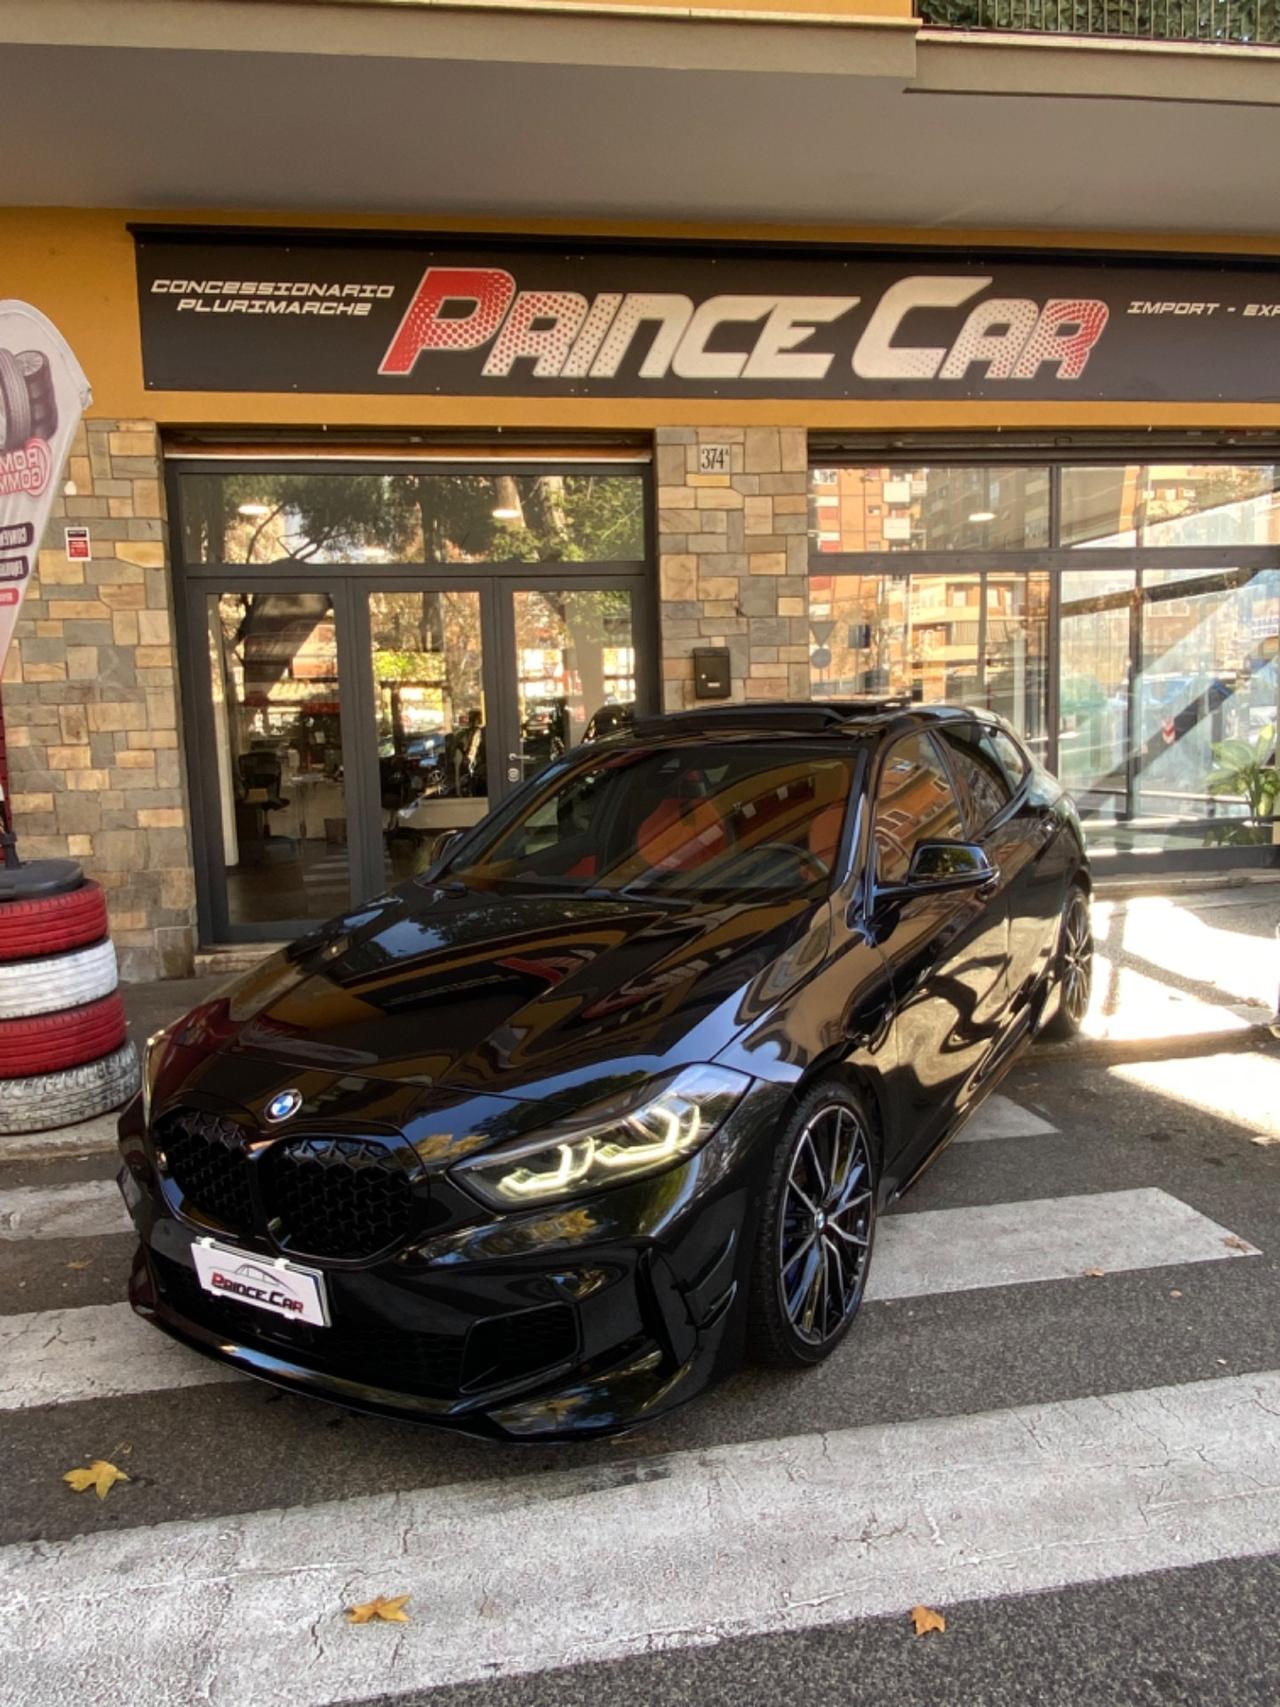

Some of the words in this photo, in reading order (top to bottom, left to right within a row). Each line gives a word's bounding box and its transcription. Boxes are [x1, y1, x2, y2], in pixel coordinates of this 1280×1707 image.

[150, 279, 396, 298] CONCESSIONARIO
[177, 298, 372, 316] PLURIMARCHE
[1127, 301, 1220, 315] IMPORT
[378, 267, 860, 378] PRINCE
[852, 275, 1109, 379] CAR
[211, 1272, 268, 1302] PRINCE
[268, 1291, 304, 1314] CAR
